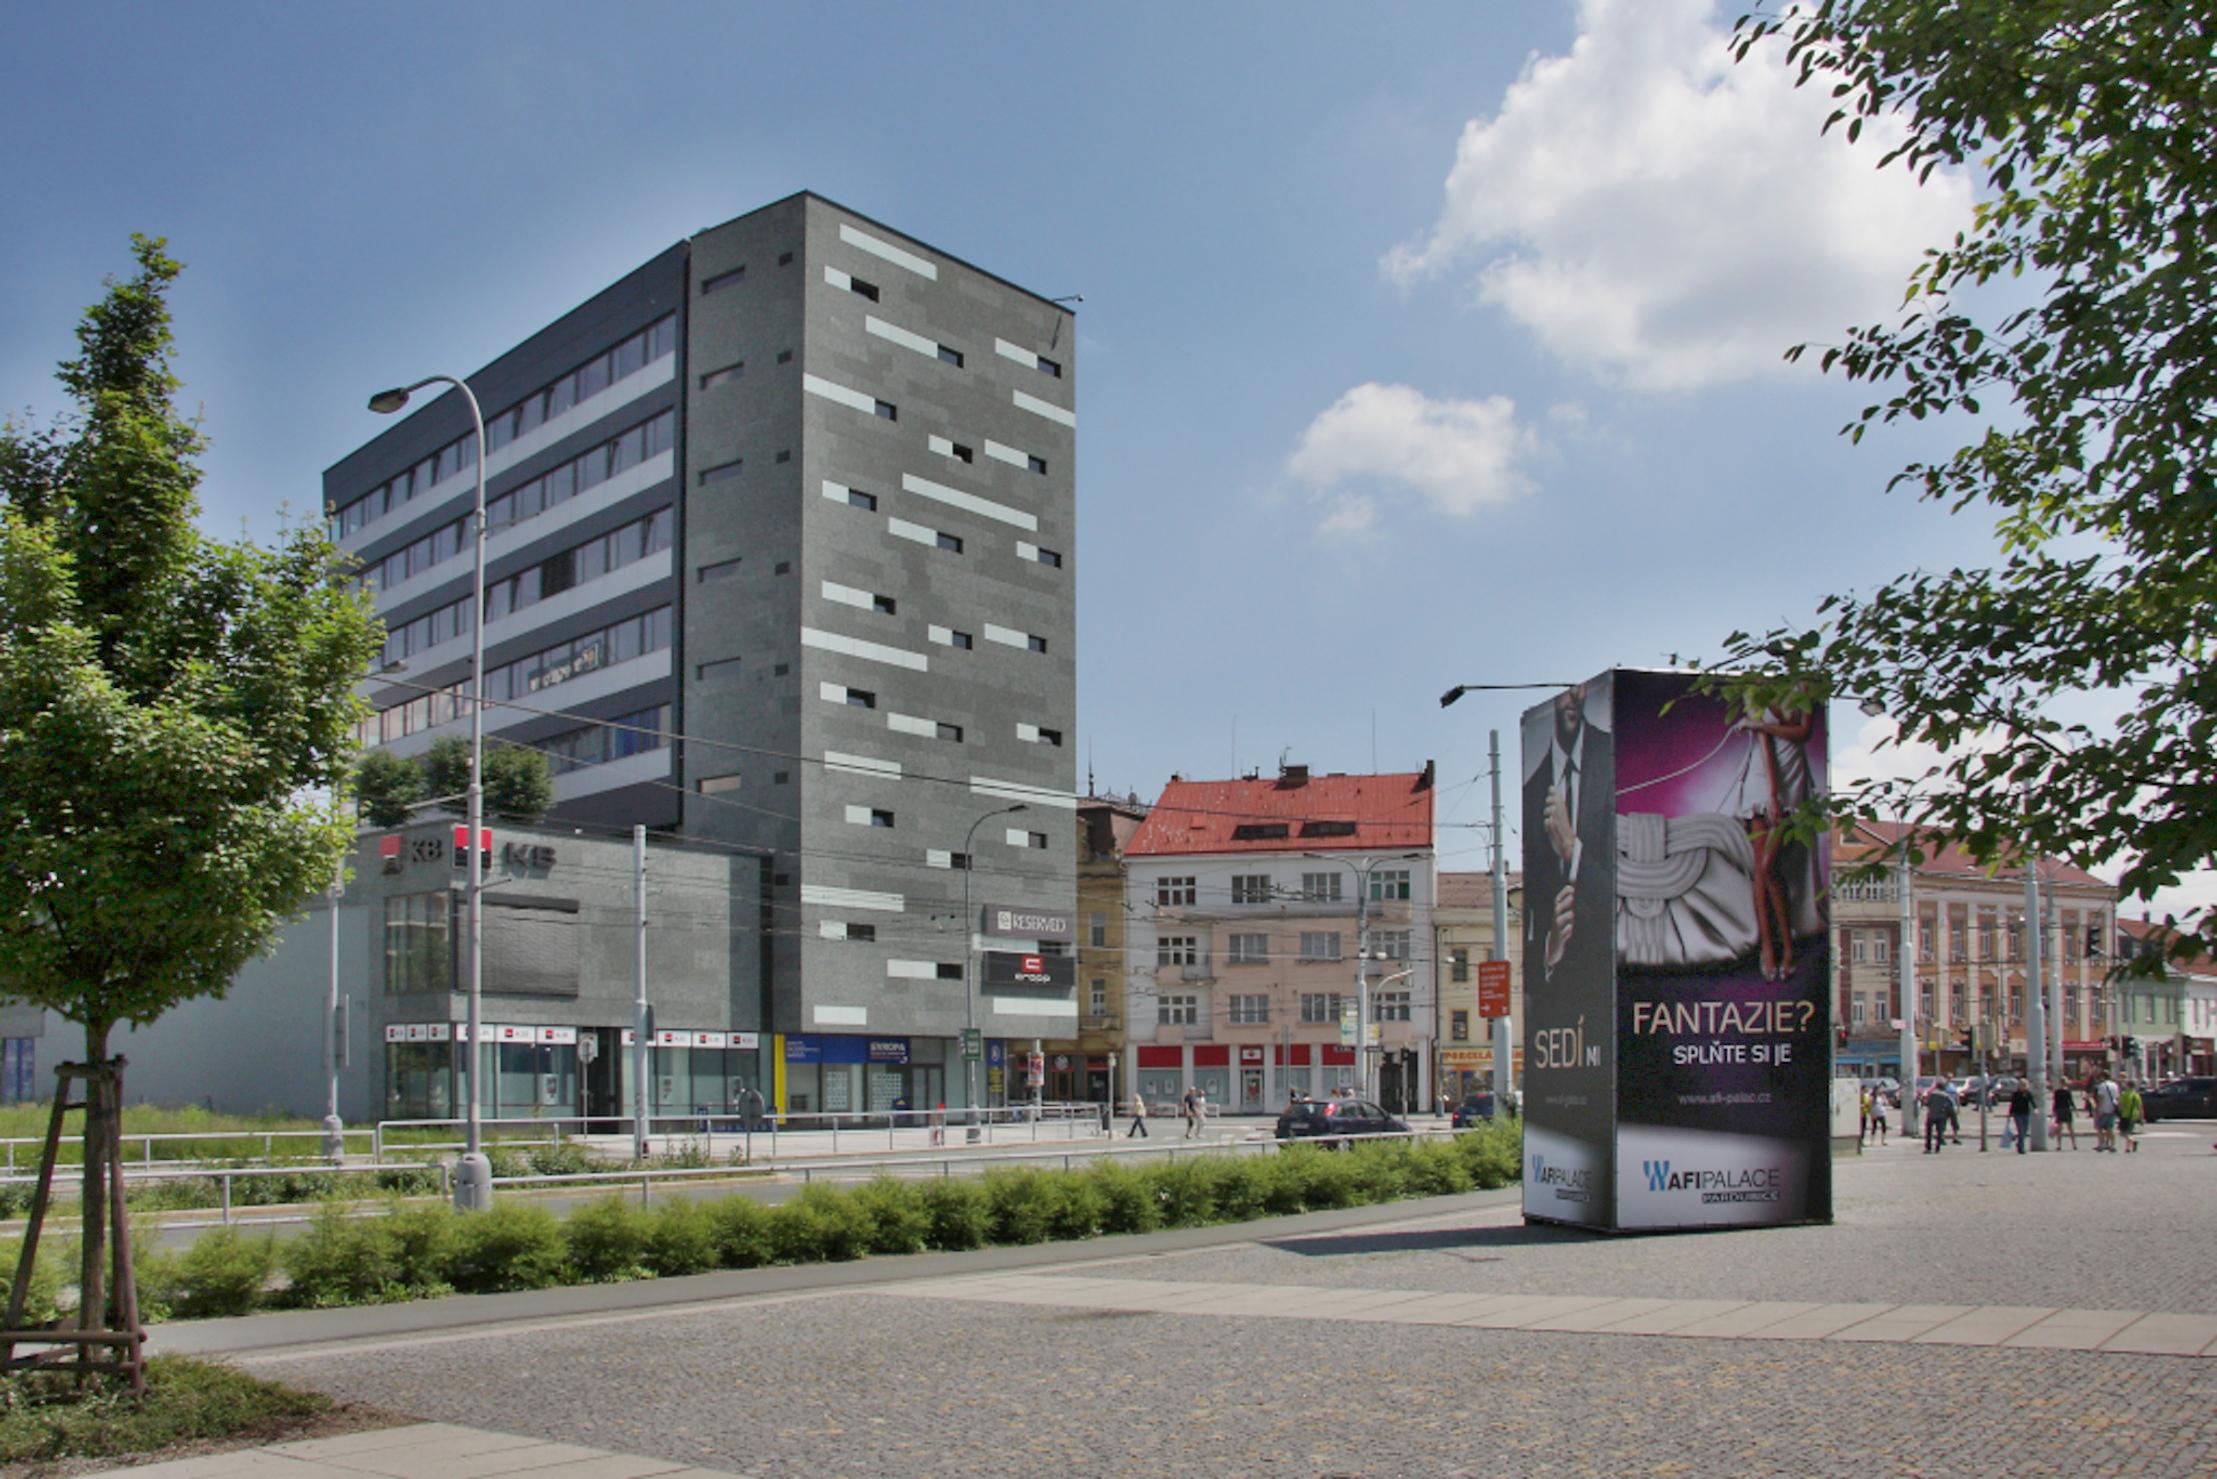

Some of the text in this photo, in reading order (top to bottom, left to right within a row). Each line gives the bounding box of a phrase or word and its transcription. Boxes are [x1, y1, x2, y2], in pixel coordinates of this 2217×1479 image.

[412, 840, 442, 863] KB
[505, 842, 556, 866] KB
[1012, 913, 1067, 933] RESERVED
[1633, 1001, 1815, 1034] FANTAZIE?
[1534, 1014, 1584, 1069] SEDÍ
[1673, 1040, 1793, 1067] SPLŇTE SI JE
